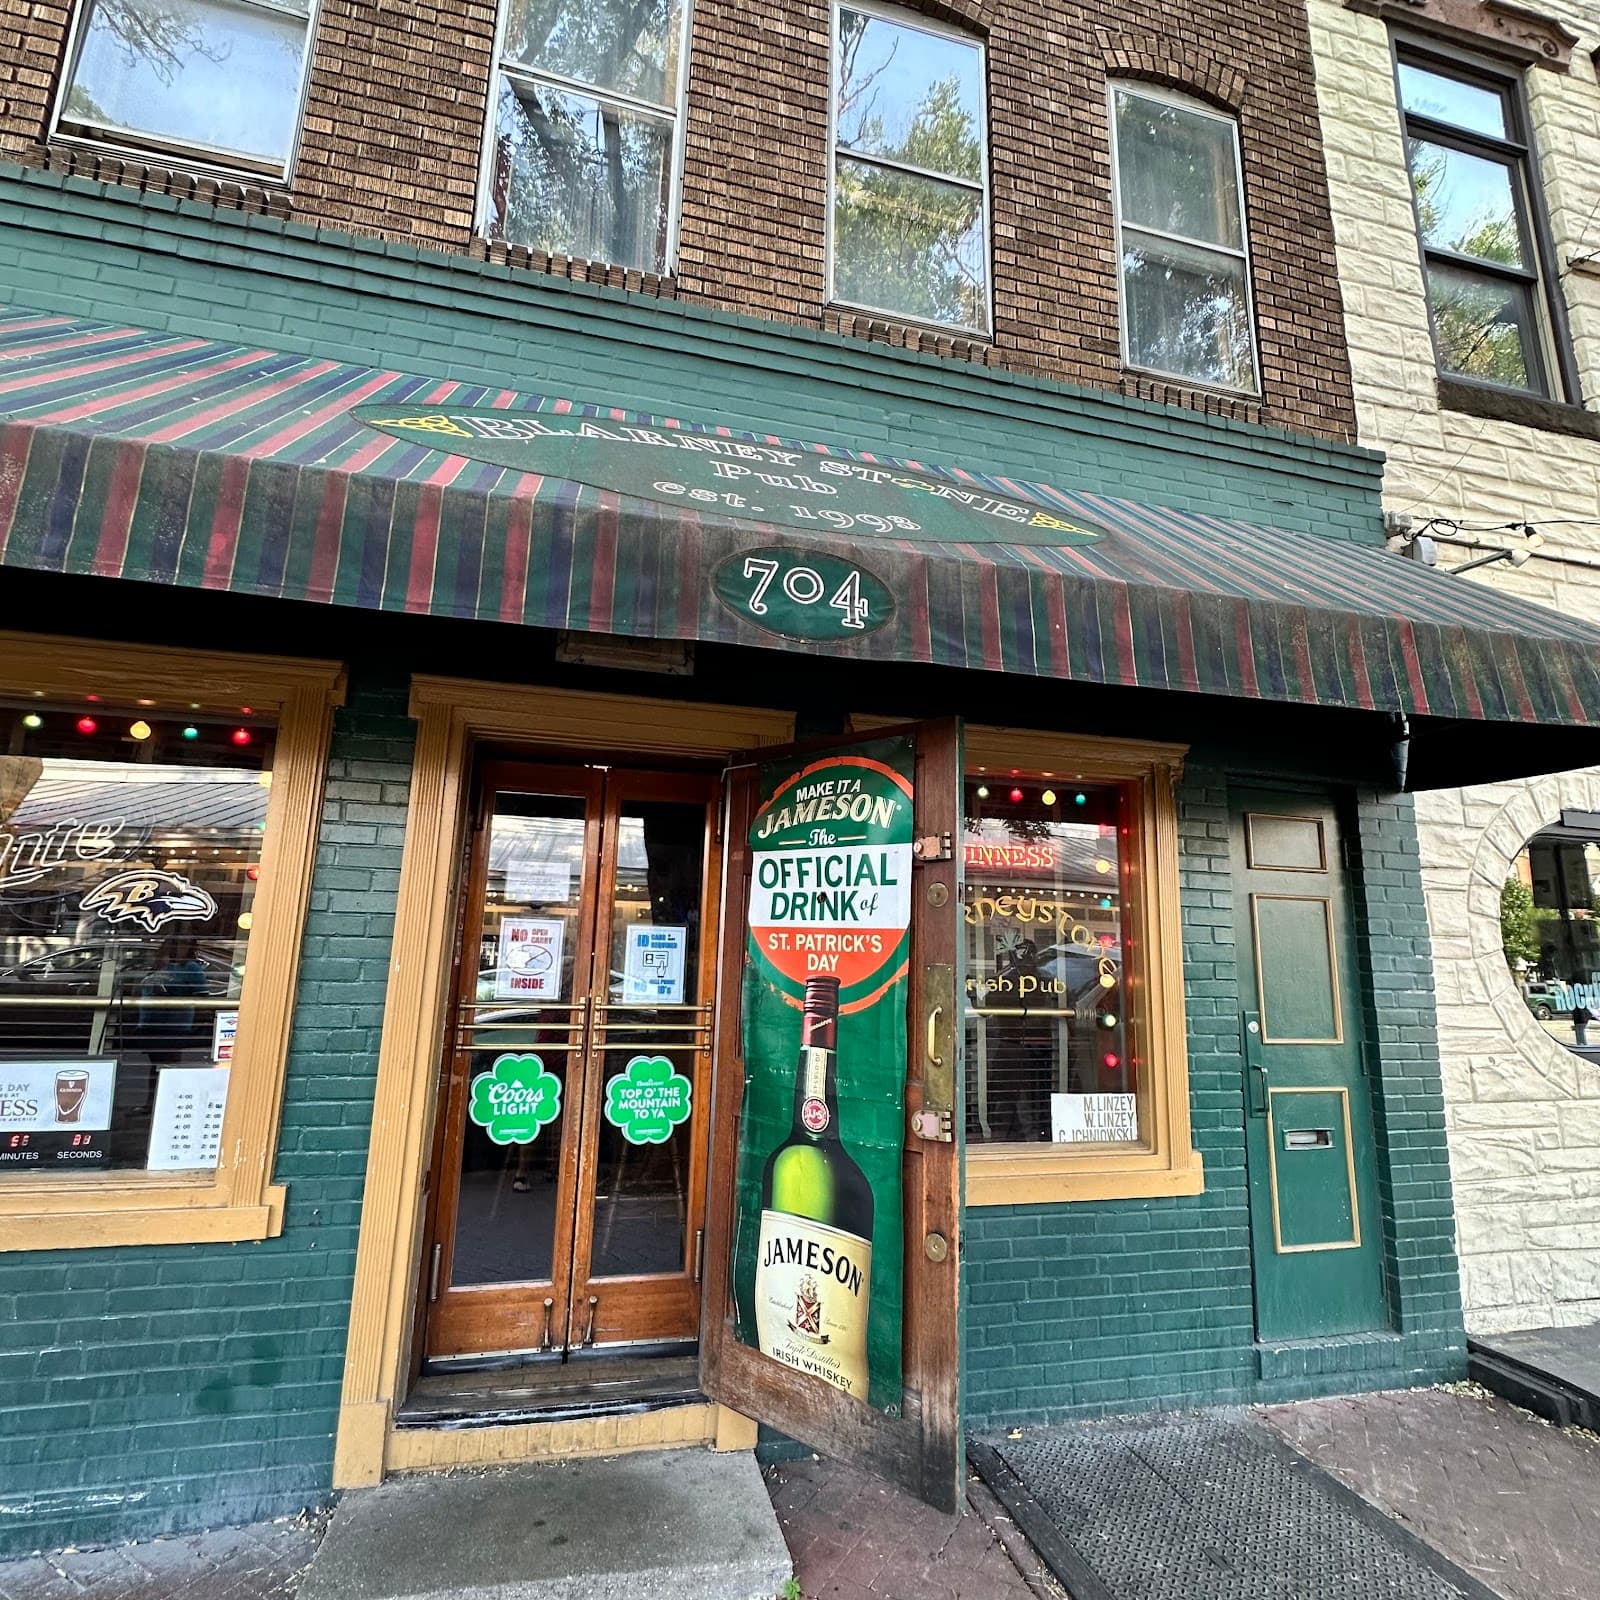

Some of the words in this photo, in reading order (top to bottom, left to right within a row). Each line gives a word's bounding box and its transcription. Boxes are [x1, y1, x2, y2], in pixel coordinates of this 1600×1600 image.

[449, 415, 802, 467] BLARNEY
[709, 460, 837, 495] Pub
[653, 481, 766, 511] est.
[743, 557, 869, 629] 704
[796, 781, 834, 802] MAKE
[837, 779, 852, 793] IT
[851, 779, 861, 793] A
[758, 793, 897, 839] JAMESON
[808, 828, 837, 846] The
[963, 843, 1054, 867] INNESS
[758, 853, 897, 889] OFFICIAL
[770, 890, 860, 921] DRINK
[860, 893, 879, 916] of
[511, 929, 528, 941] NO
[637, 934, 649, 947] ID
[768, 933, 790, 950] ST.
[796, 933, 882, 953] PATRICK'S
[807, 954, 839, 972] DAY
[510, 978, 544, 989] INSIDE
[966, 975, 1013, 992] rish
[1020, 975, 1066, 998] Pub
[8, 1083, 30, 1092] DAY
[488, 1082, 544, 1104] Coors
[620, 1089, 642, 1099] TOP
[658, 1087, 680, 1098] THE
[0, 1099, 38, 1117] ESS
[493, 1103, 539, 1116] LIGHT
[618, 1098, 681, 1110] MOUNTAIN
[1083, 1096, 1096, 1112] M.
[1097, 1095, 1134, 1111] LINZEY
[633, 1109, 649, 1119] TO
[651, 1108, 665, 1118] YA
[1084, 1112, 1096, 1128] W.
[1097, 1112, 1134, 1128] LINZEY
[57, 1150, 102, 1160] SECONDS
[764, 1238, 864, 1297] JAMESON
[772, 1347, 799, 1367] IRISH
[802, 1359, 852, 1390] WHISKEY
